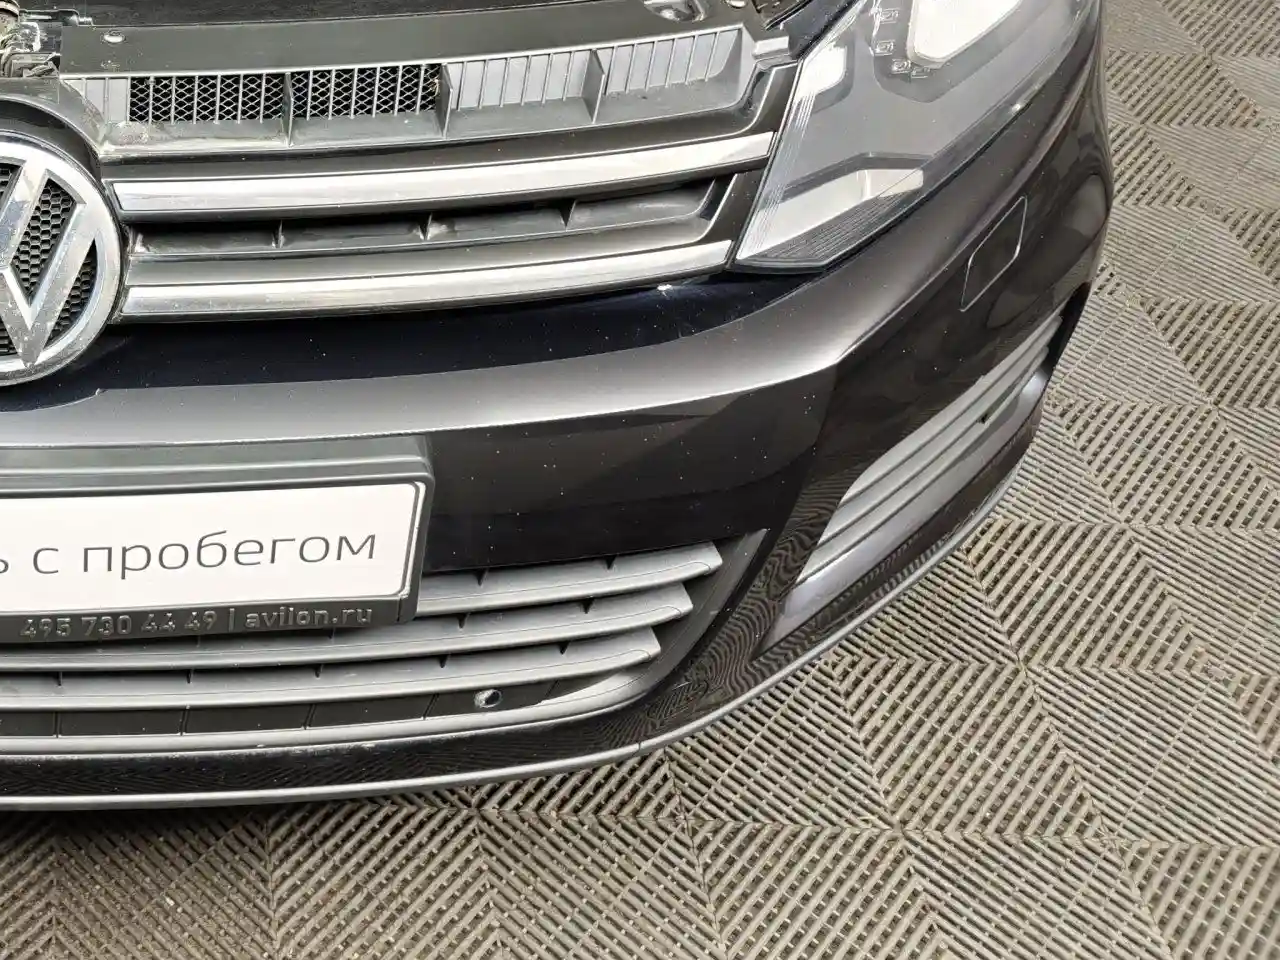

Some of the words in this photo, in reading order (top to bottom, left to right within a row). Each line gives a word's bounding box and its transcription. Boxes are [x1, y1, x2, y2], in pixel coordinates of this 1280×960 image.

[32, 547, 60, 575] с
[82, 530, 376, 580] пробегом
[20, 618, 72, 639] 495
[81, 615, 132, 639] 730
[140, 613, 177, 634] 44
[184, 610, 217, 633] 49
[244, 606, 373, 629] avilon.ru
